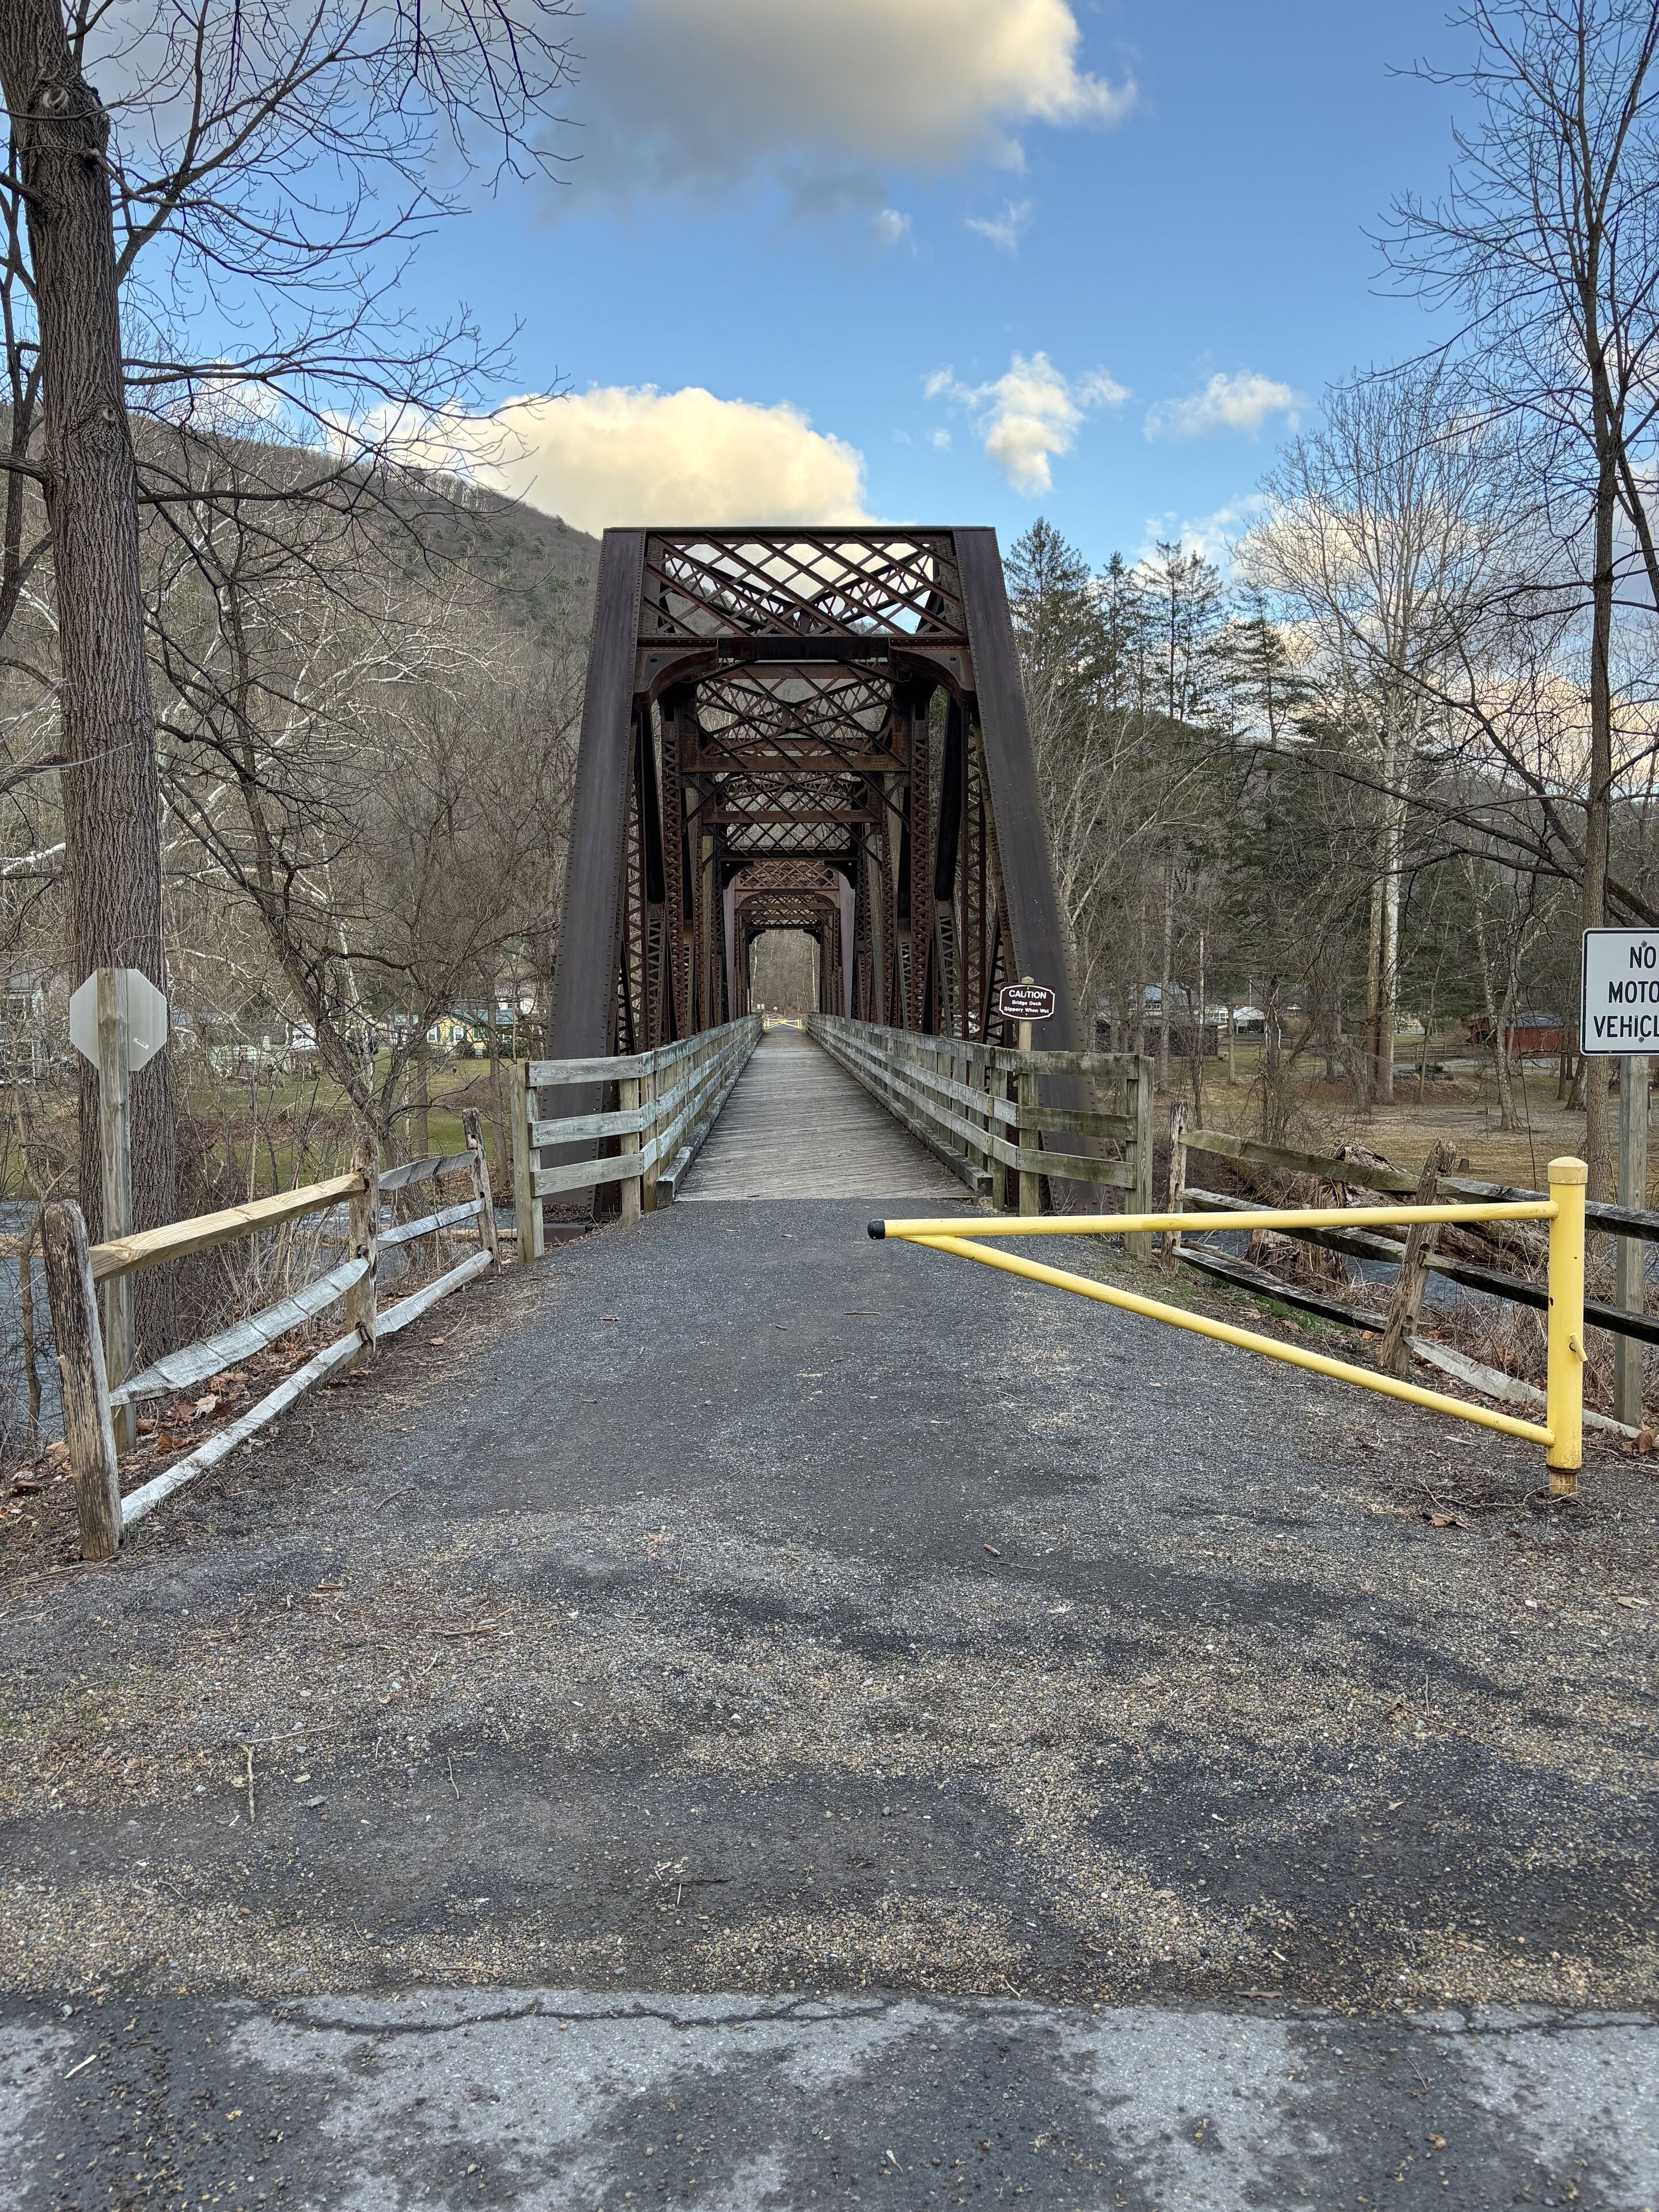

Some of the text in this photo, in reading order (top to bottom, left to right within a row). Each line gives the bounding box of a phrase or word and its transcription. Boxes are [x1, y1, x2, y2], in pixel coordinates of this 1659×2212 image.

[1630, 946, 1657, 969] NO
[1009, 990, 1047, 999] CAUTION
[1608, 980, 1659, 1003] MOTO
